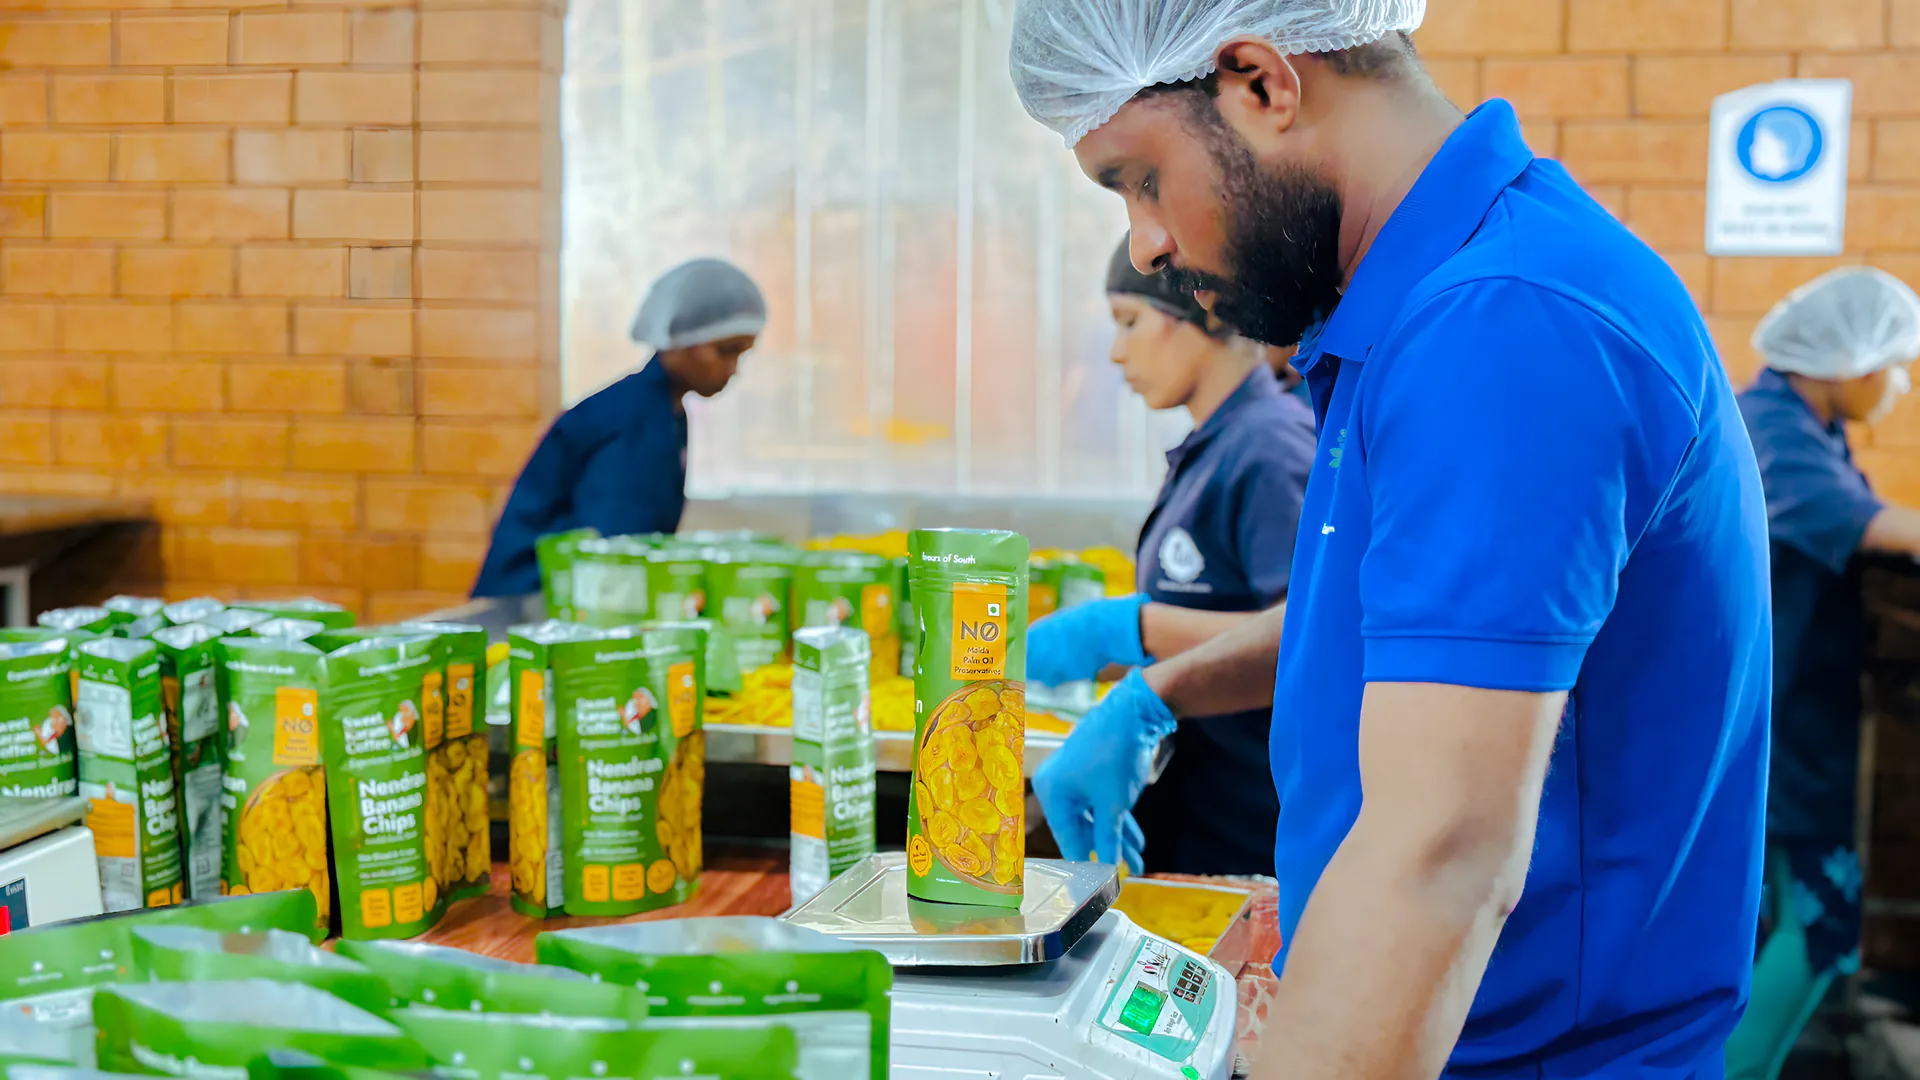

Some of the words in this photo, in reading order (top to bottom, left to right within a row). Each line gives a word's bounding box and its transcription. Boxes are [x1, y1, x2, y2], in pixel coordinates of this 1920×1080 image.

[943, 553, 952, 563] of
[953, 554, 976, 564] South
[960, 620, 999, 642] NO
[954, 665, 1002, 675] Preservatives
[963, 656, 981, 664] Palm
[982, 656, 994, 664] Oil
[587, 756, 664, 778] Nendran
[360, 792, 422, 817] Banana
[589, 795, 641, 815] Chips
[362, 813, 416, 835] Chips
